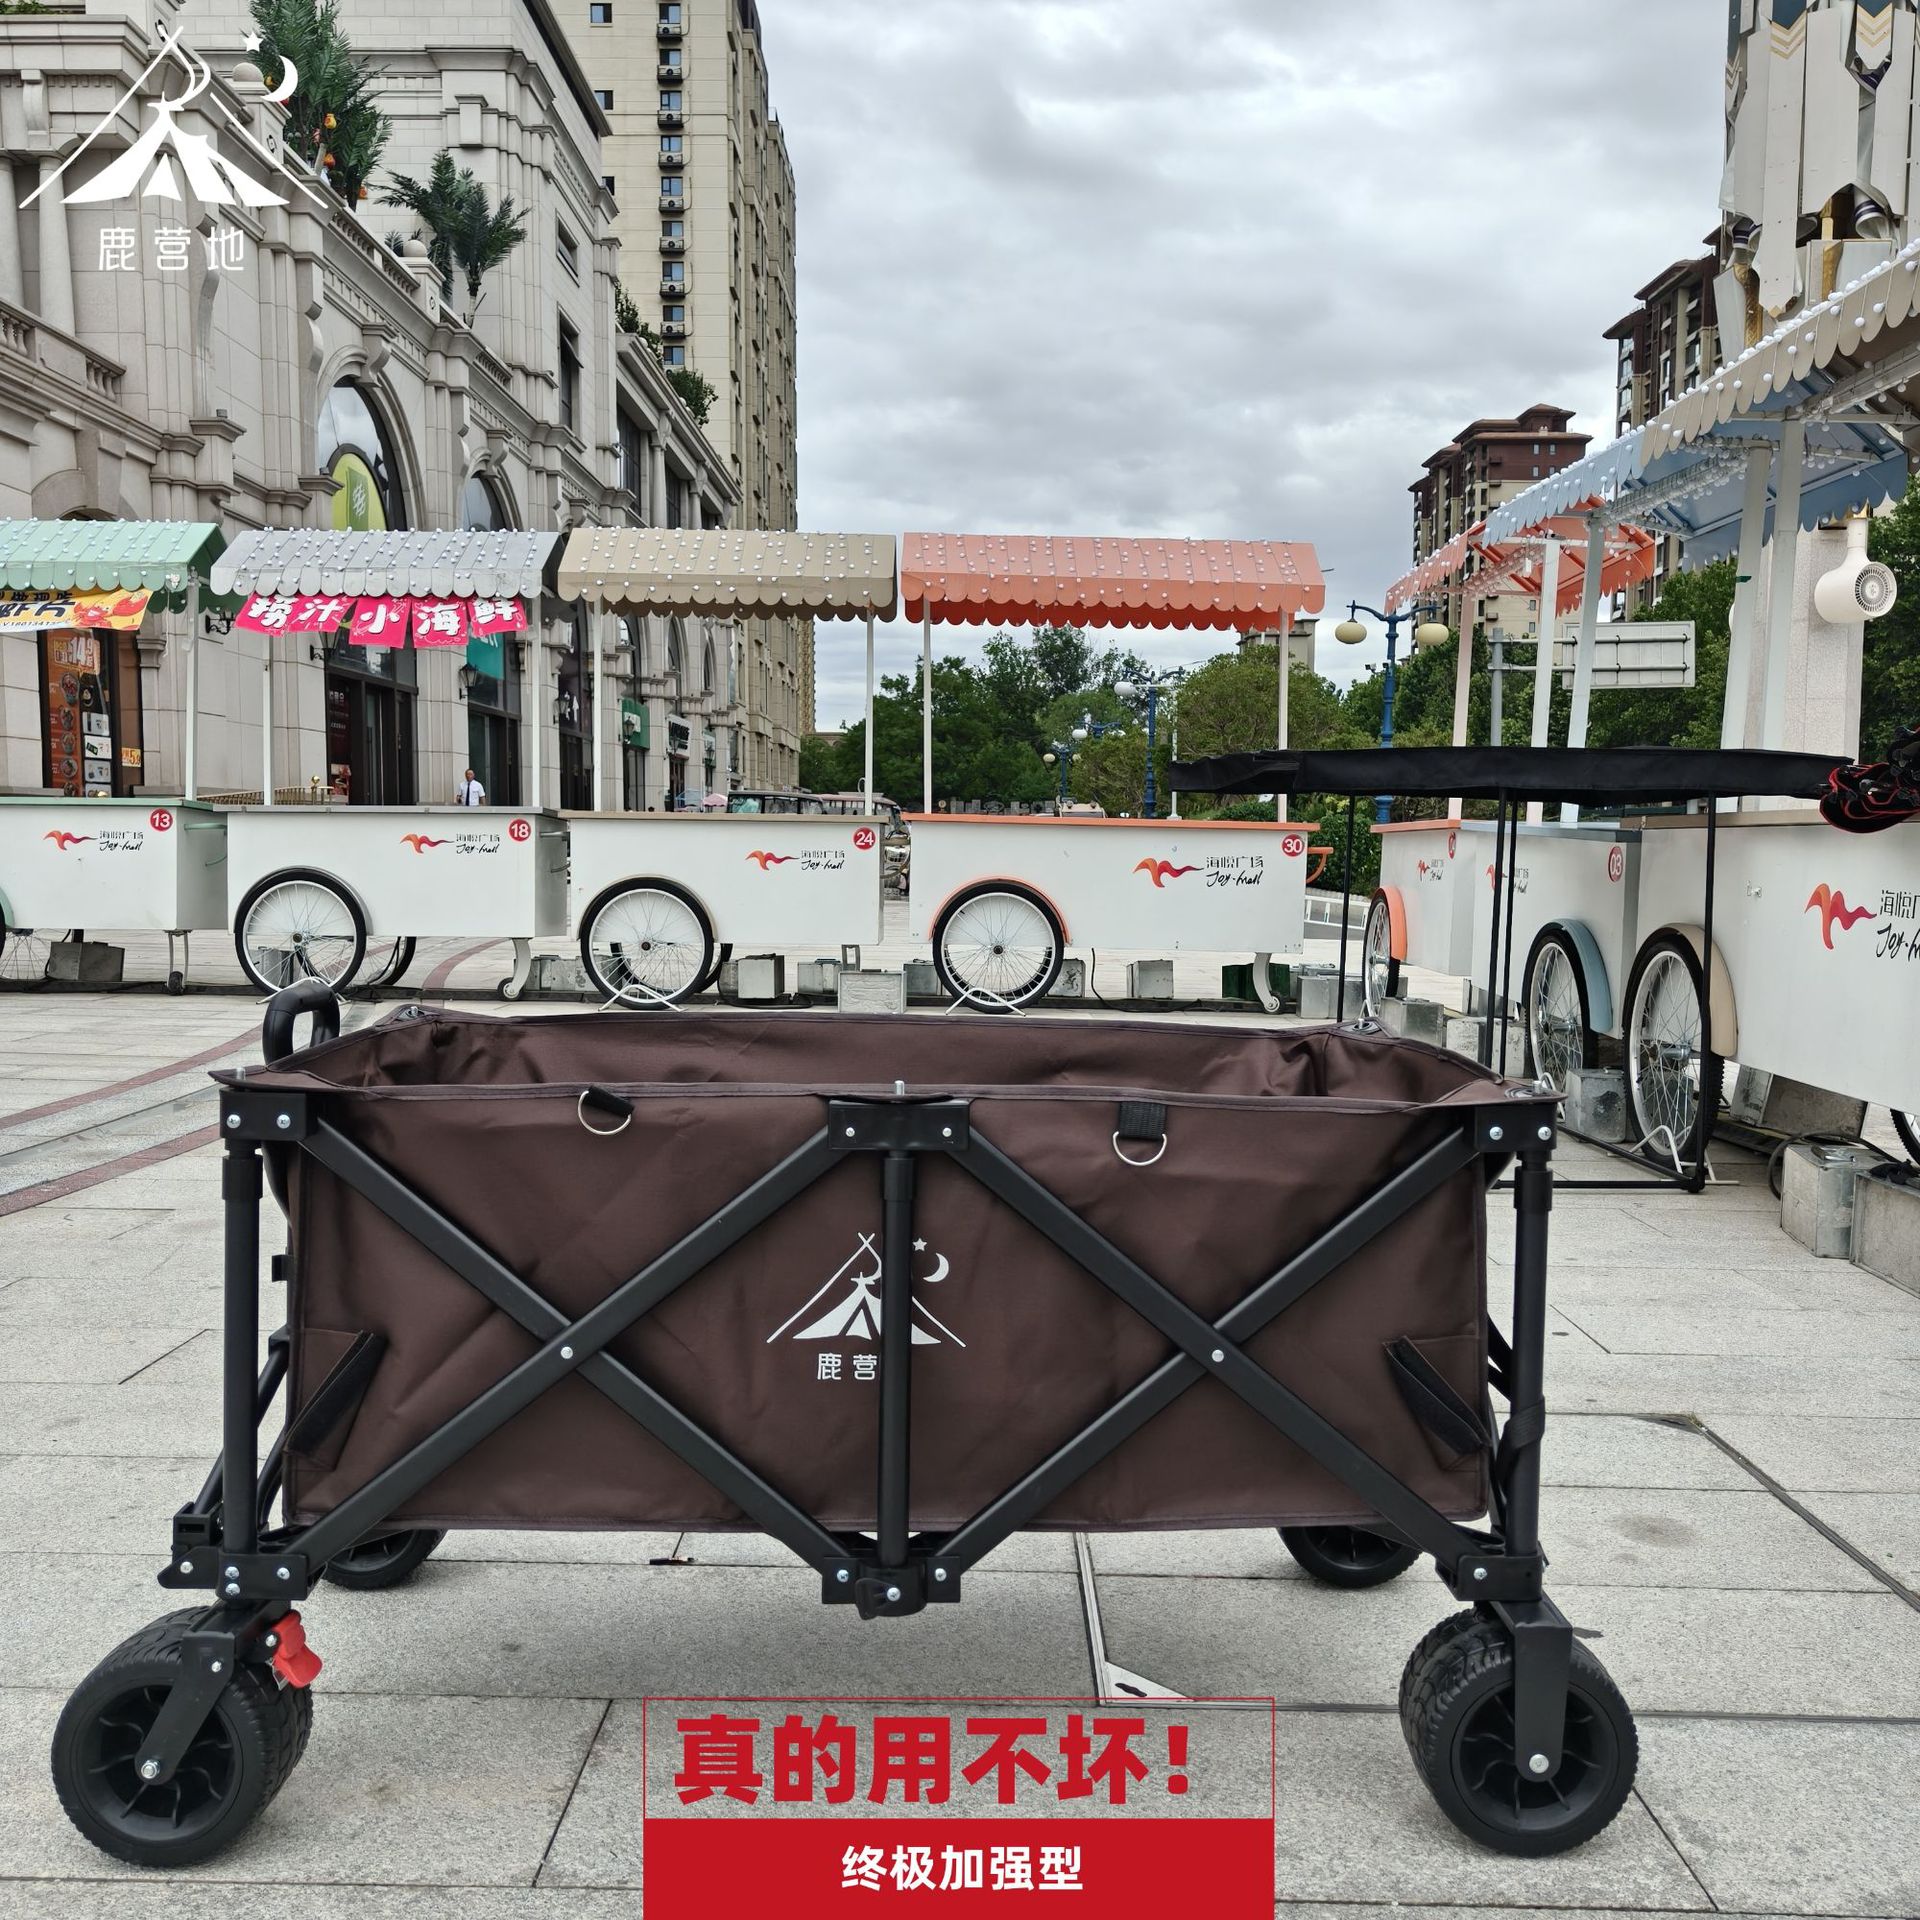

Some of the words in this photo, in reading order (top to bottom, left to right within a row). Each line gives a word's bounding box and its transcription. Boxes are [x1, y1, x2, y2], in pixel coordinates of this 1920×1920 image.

[248, 596, 518, 636] 捞汁小海鲜
[152, 812, 170, 828] 13
[511, 823, 529, 838] 18
[855, 831, 874, 846] 24
[1283, 838, 1303, 854] 30
[1611, 853, 1623, 876] 03
